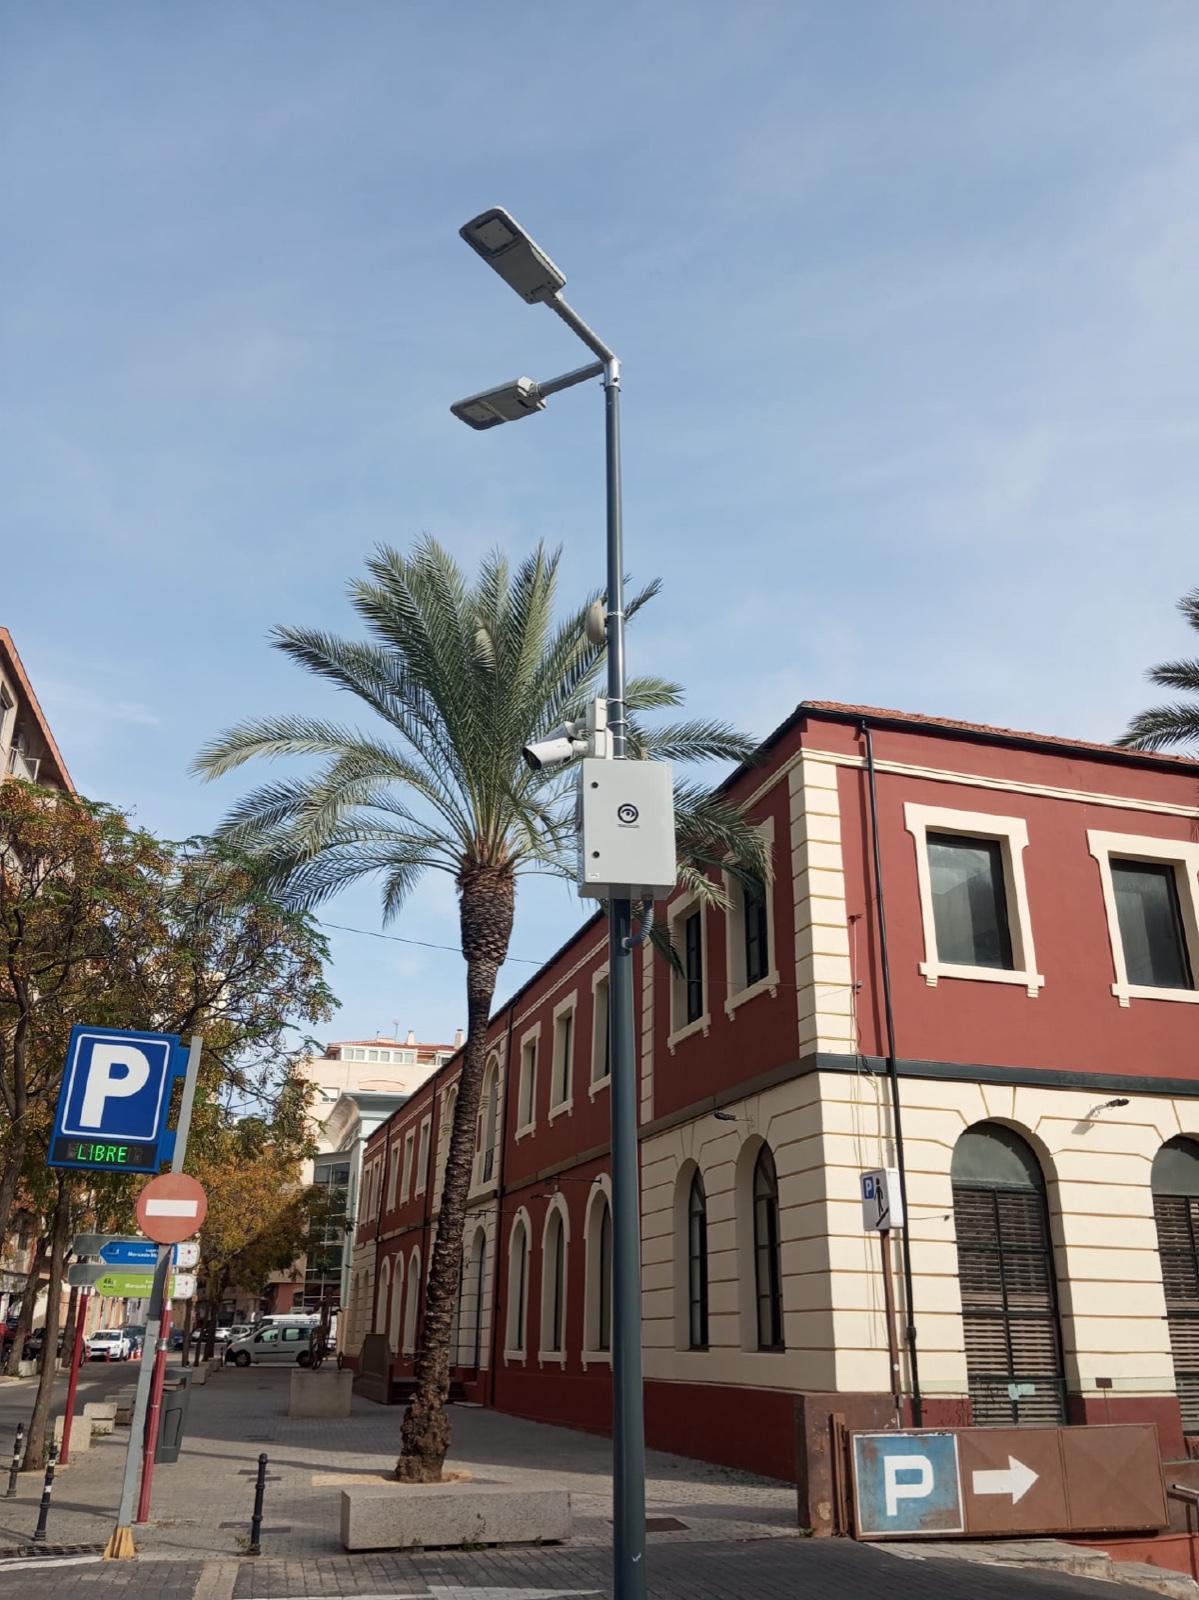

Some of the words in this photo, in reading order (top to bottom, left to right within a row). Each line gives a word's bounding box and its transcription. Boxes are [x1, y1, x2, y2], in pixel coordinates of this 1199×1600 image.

[79, 1043, 150, 1128] P
[77, 1143, 128, 1163] LIBRE
[865, 1179, 873, 1198] P
[884, 1455, 934, 1516] P
